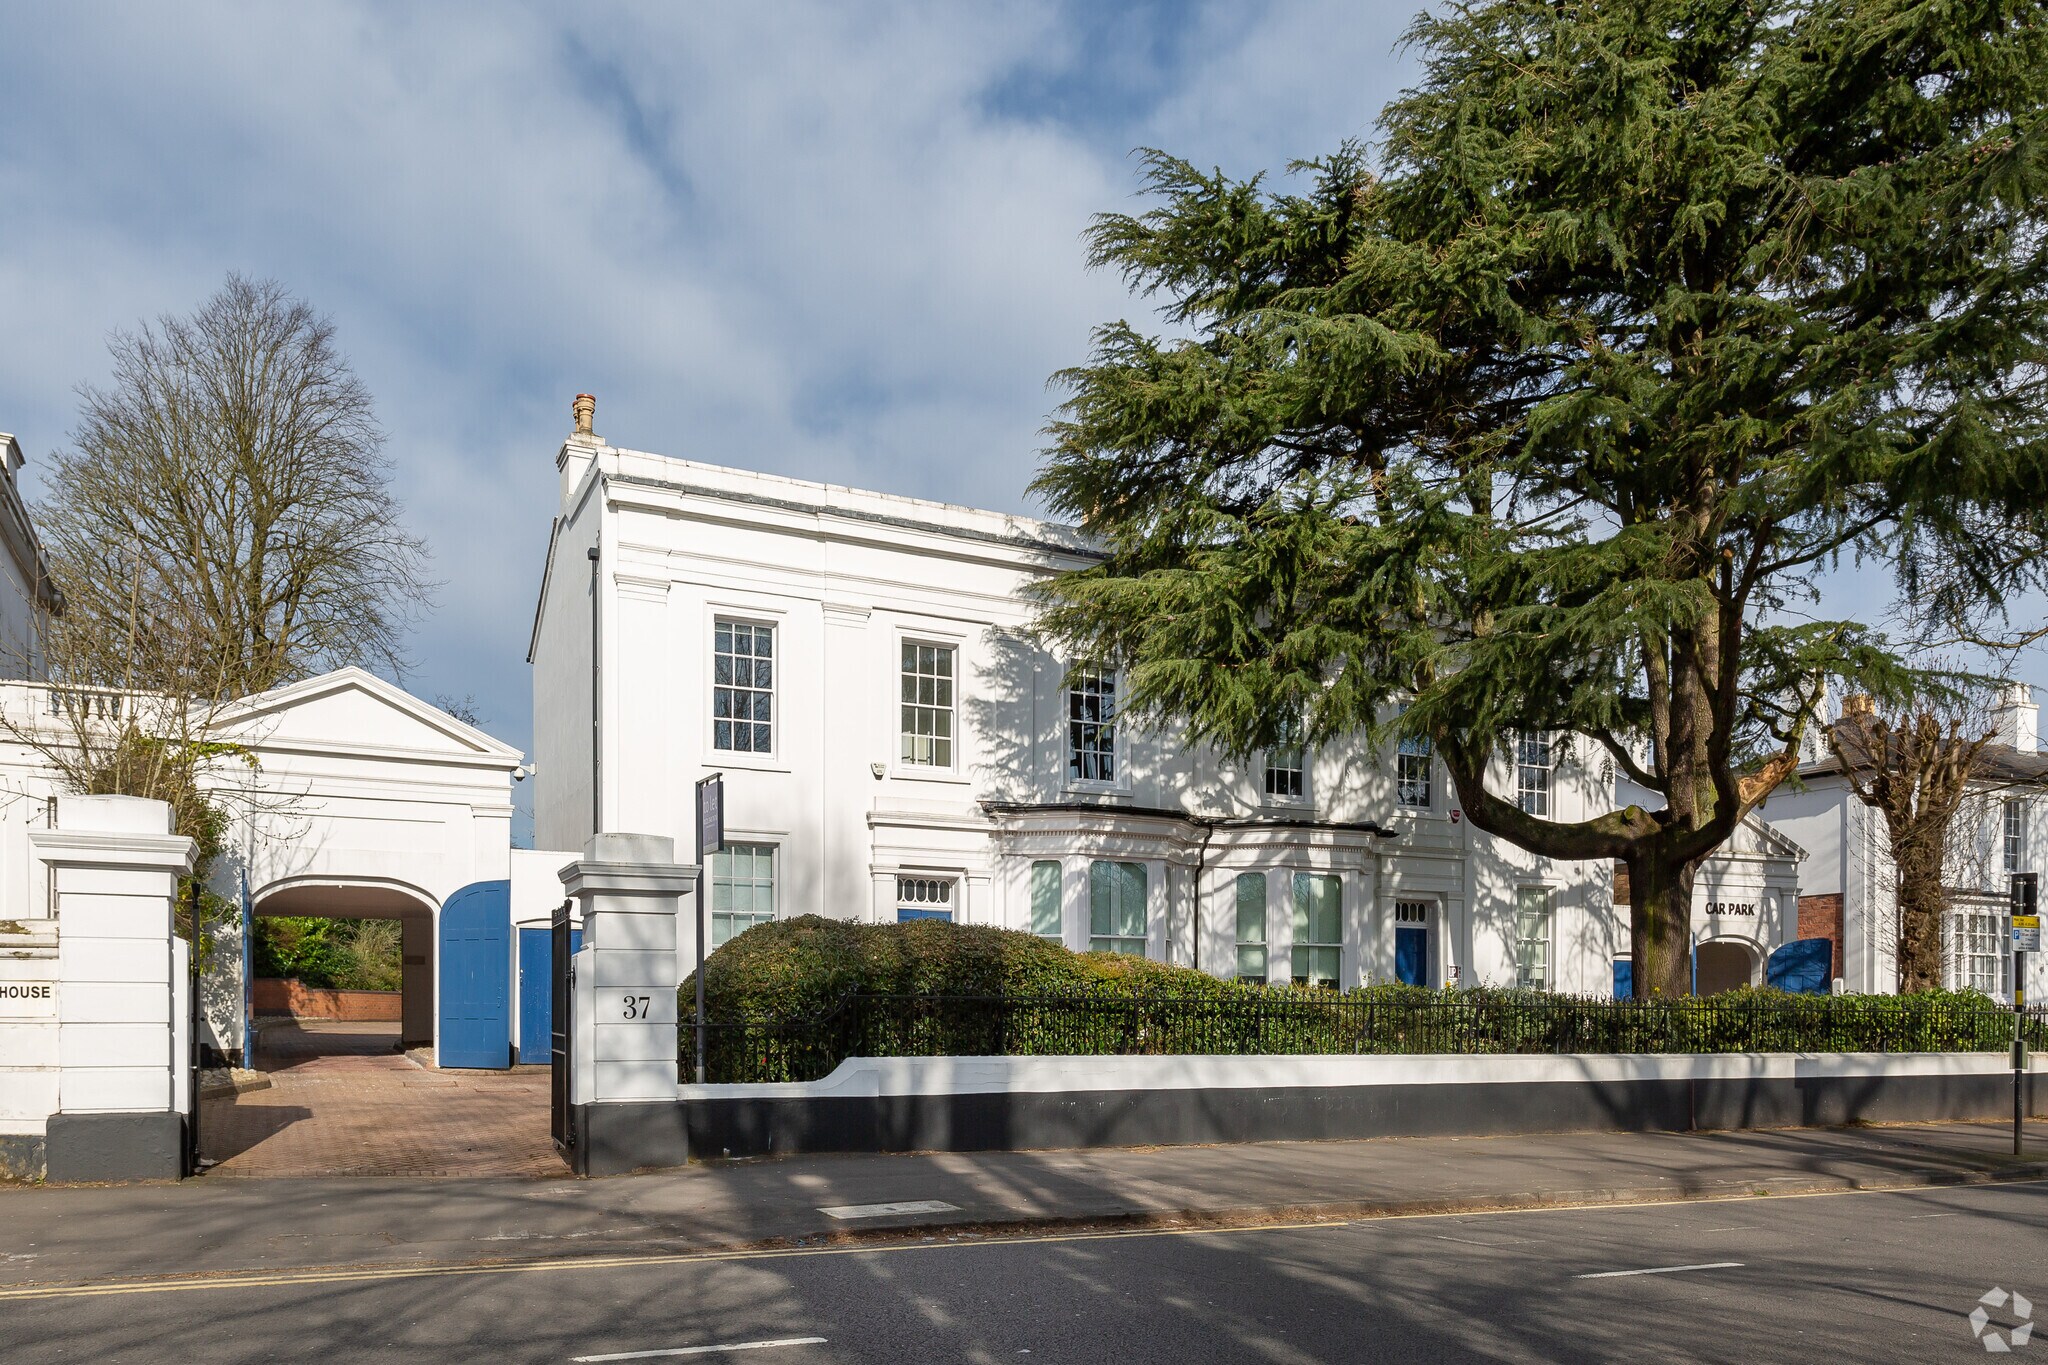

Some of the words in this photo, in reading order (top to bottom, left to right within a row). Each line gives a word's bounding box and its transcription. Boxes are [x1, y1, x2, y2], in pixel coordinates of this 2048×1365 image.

[1705, 902, 1726, 915] CAR
[1728, 903, 1755, 916] PARK
[2014, 930, 2019, 939] P
[0, 986, 51, 999] HOUSE
[623, 995, 650, 1020] 37
